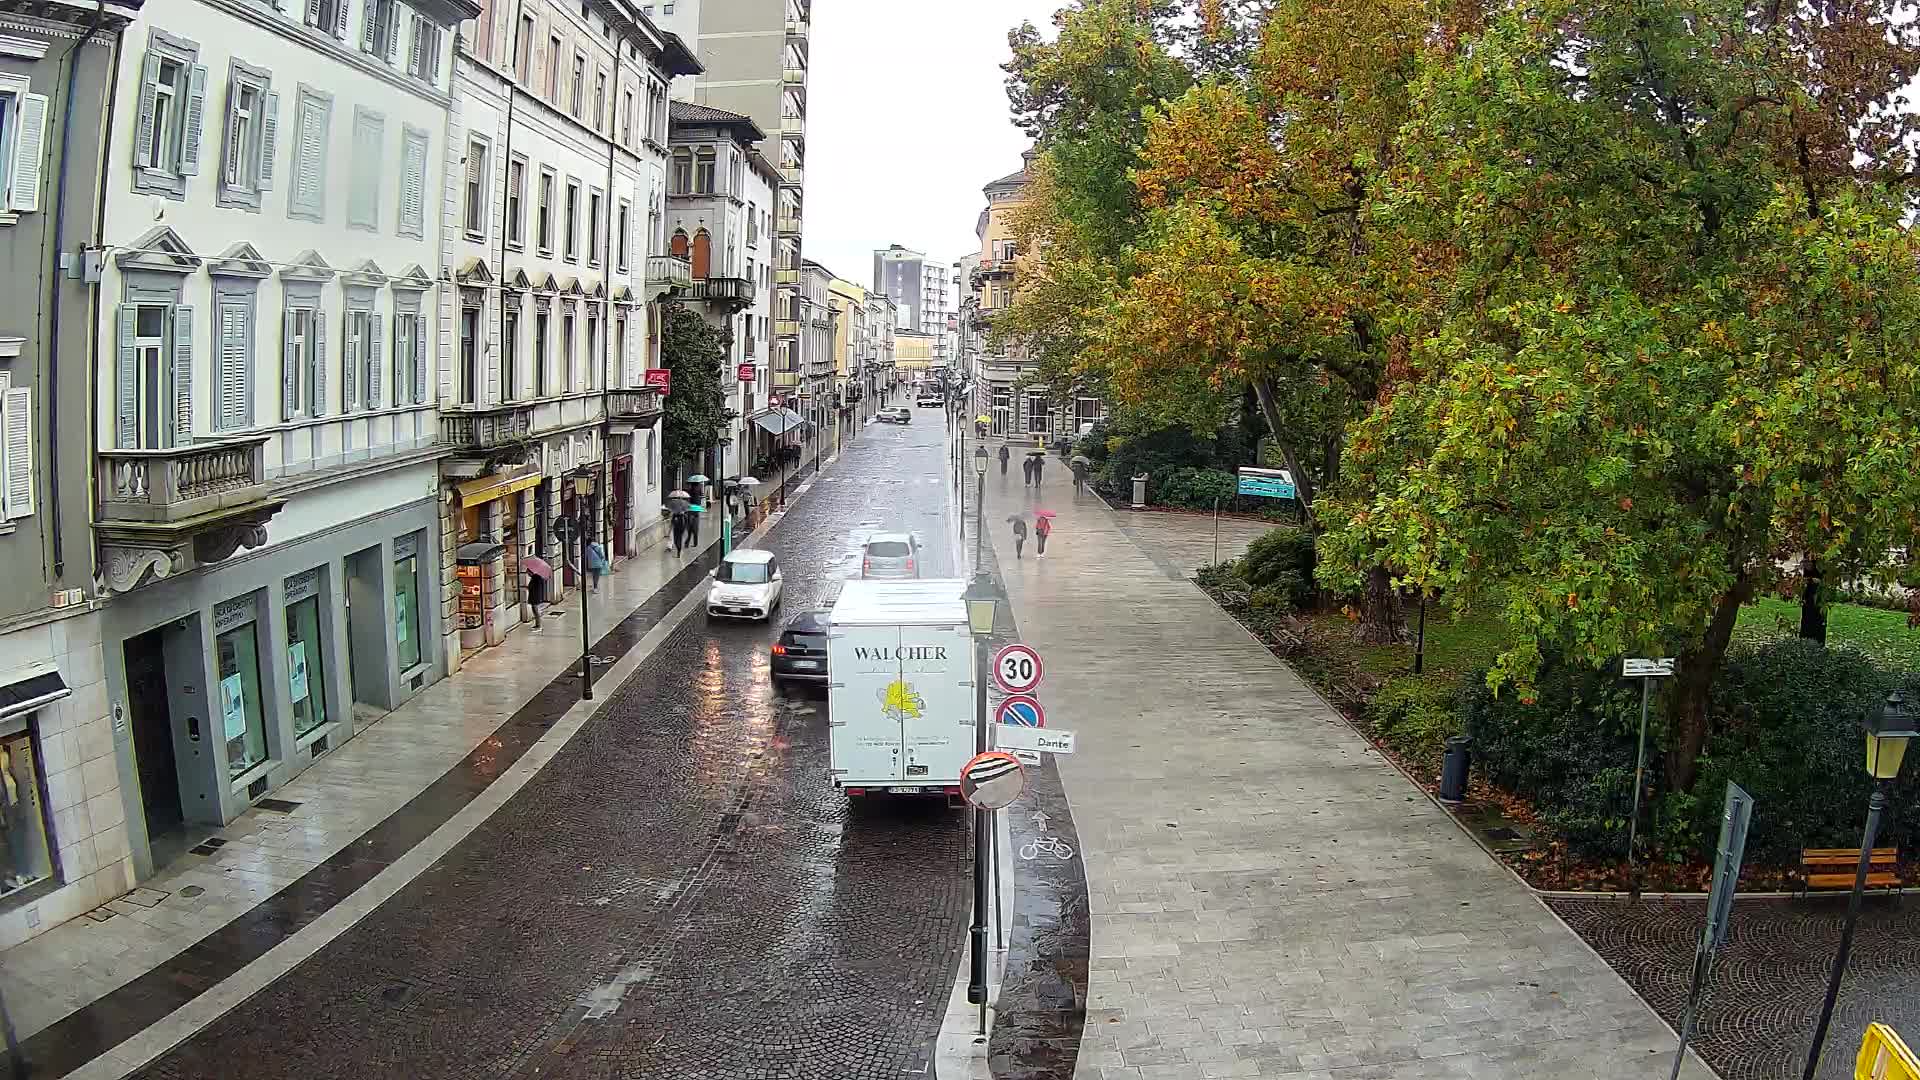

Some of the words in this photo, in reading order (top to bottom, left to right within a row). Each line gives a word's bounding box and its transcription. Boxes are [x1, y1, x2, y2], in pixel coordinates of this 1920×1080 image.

[855, 646, 948, 661] WALCHER
[1004, 658, 1033, 680] 30
[1037, 737, 1069, 749] Dante
